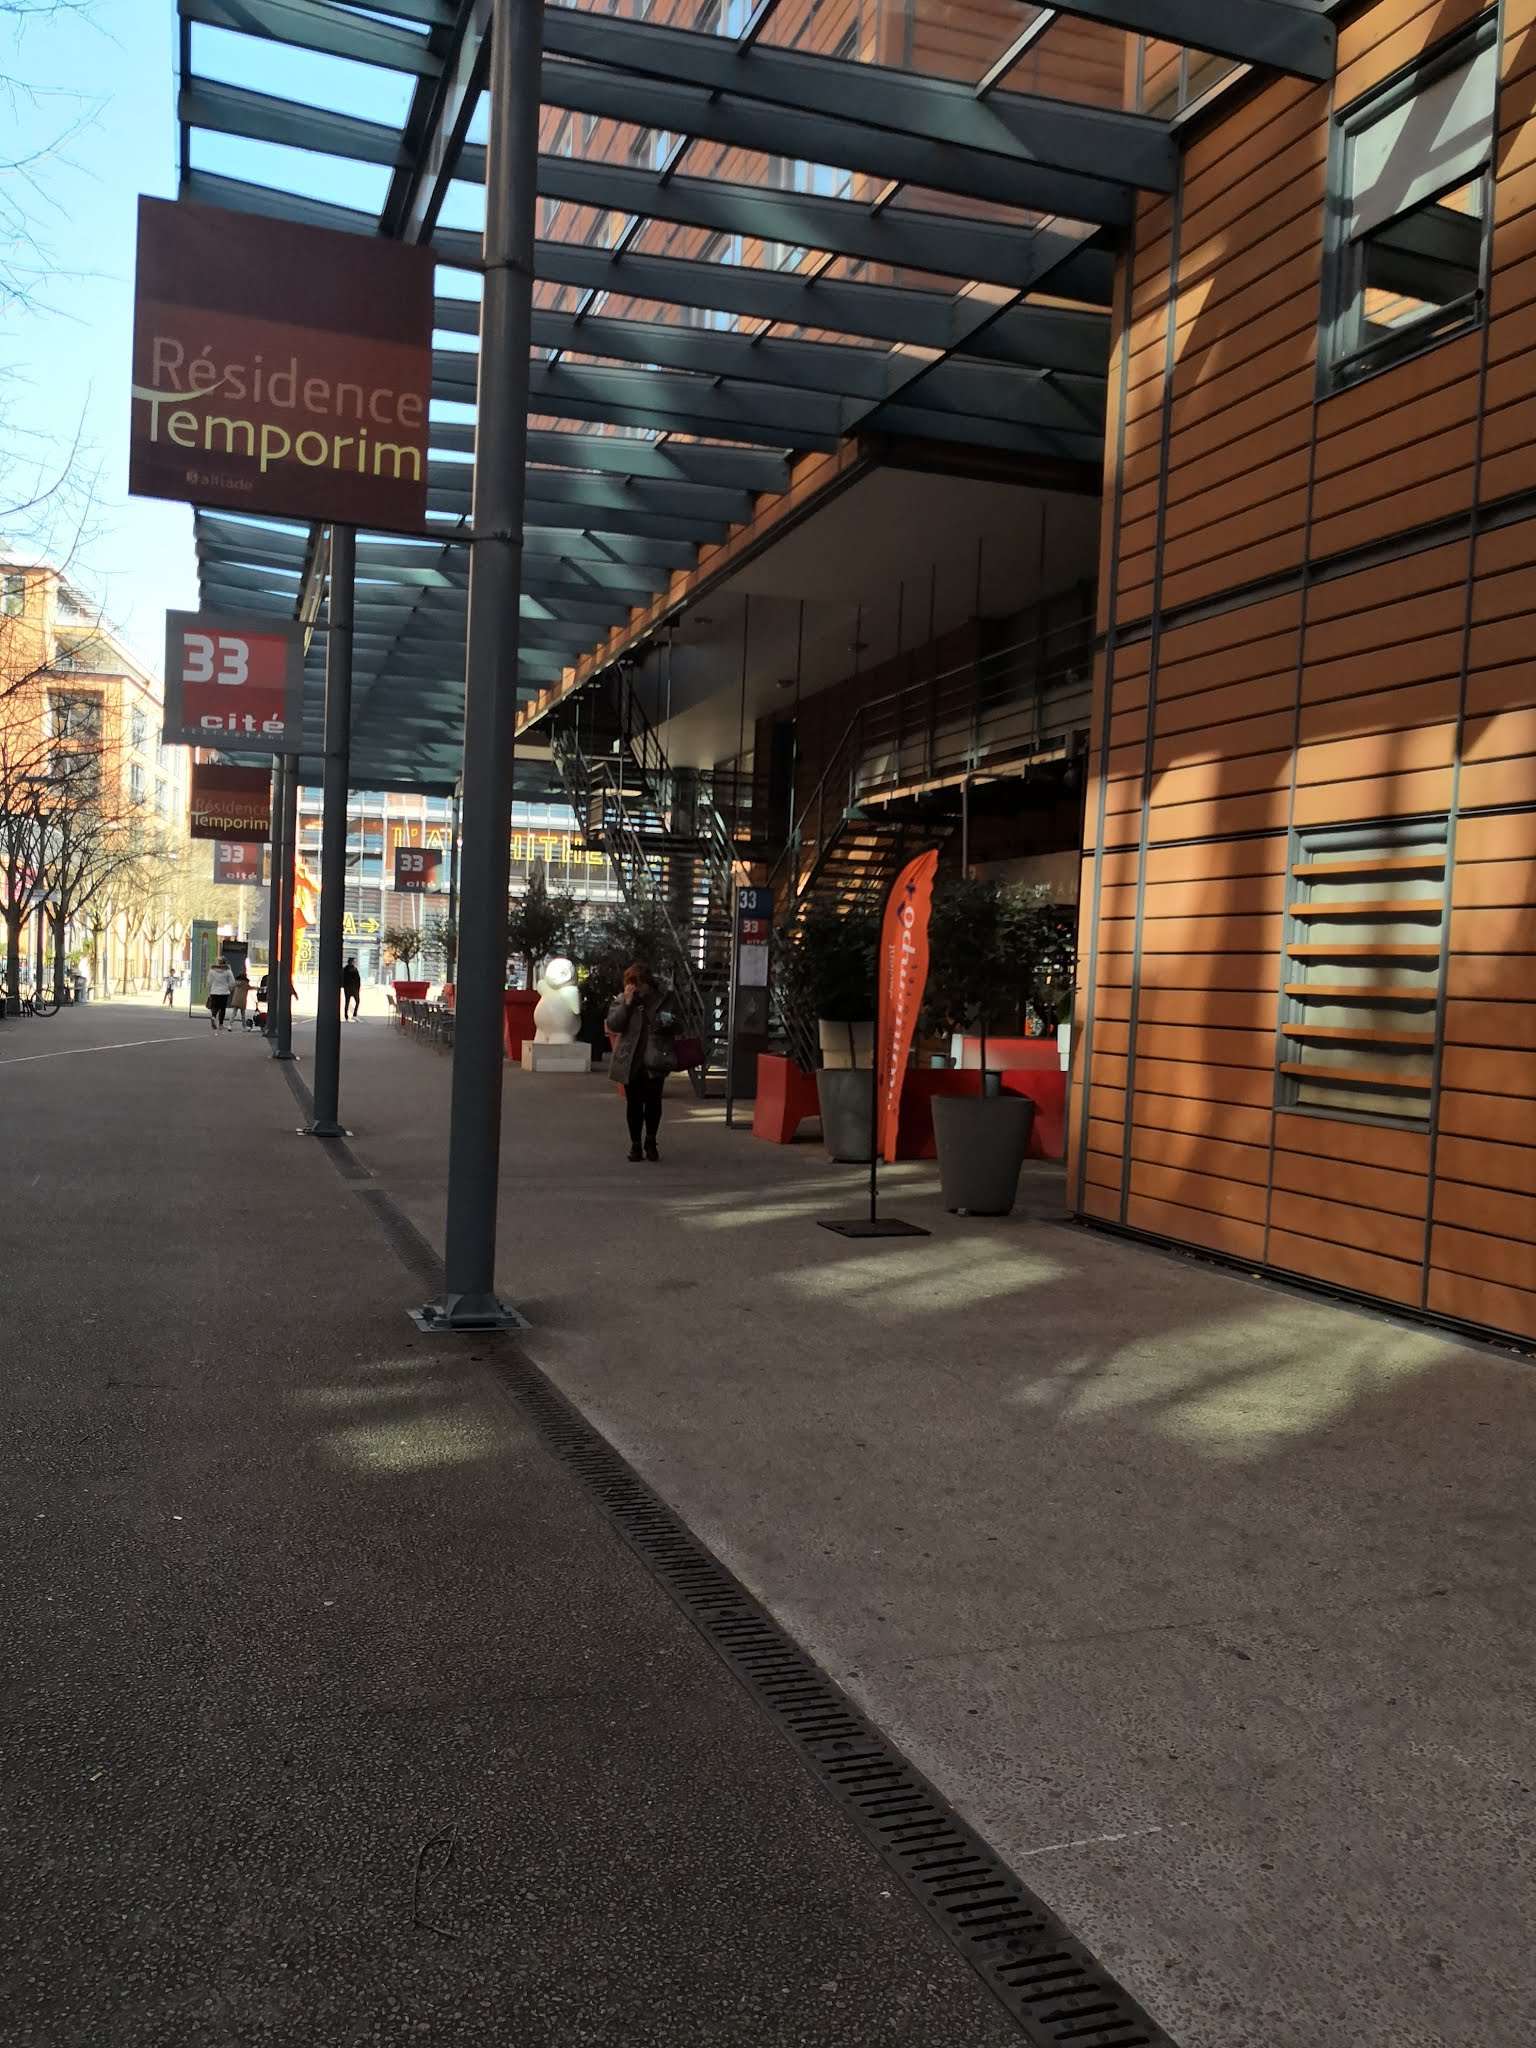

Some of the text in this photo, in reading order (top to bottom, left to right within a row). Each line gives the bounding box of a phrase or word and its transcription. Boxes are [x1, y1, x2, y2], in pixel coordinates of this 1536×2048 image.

[152, 336, 424, 429] Résidence
[131, 380, 421, 481] Temporim
[182, 632, 249, 685] 33
[200, 712, 285, 734] cité
[195, 798, 269, 816] Résidence
[191, 811, 269, 831] Temporim
[220, 844, 244, 863] 33
[400, 853, 424, 872] 33
[739, 889, 758, 910] 33
[743, 919, 759, 934] 33
